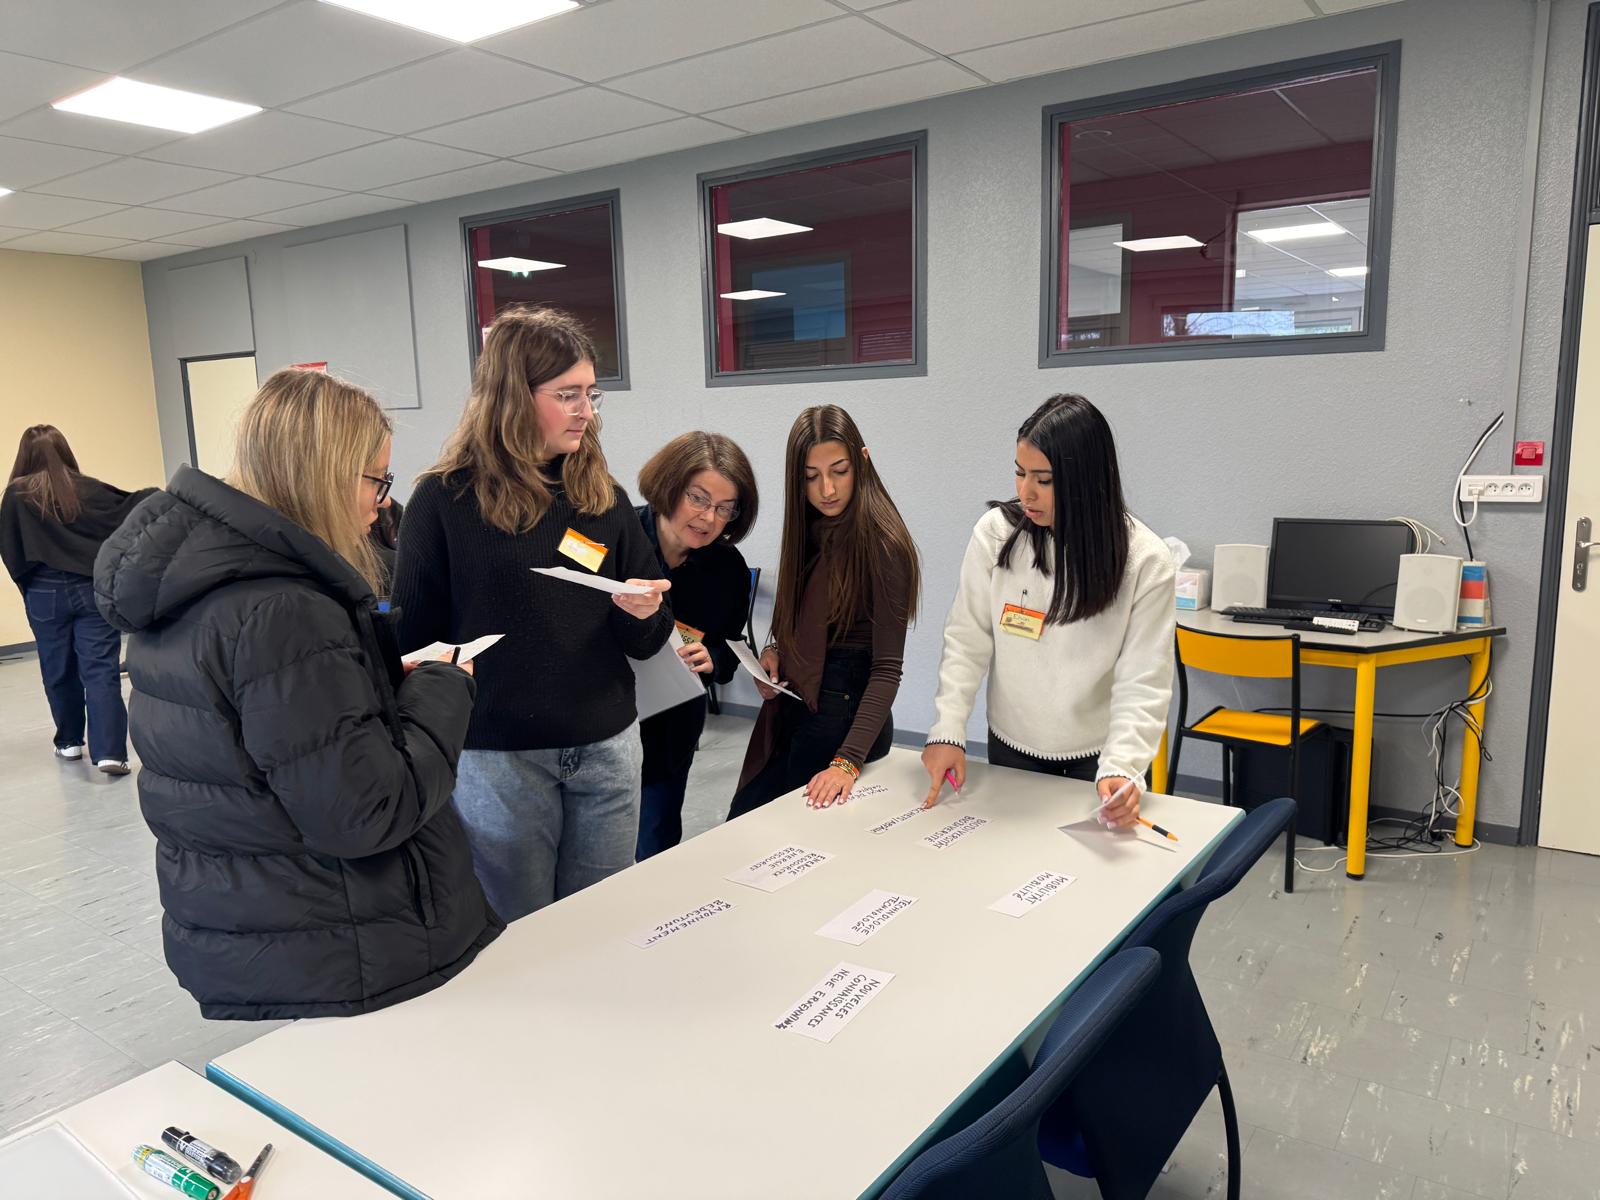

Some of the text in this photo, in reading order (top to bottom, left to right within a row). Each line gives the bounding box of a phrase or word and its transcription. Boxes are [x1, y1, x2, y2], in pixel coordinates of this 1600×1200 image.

[645, 902, 731, 945] RAYONNEMENT
[654, 900, 724, 931] BEDEUTUNG
[861, 898, 912, 935] TECHNOLOGIE
[824, 968, 850, 989] NEUE
[807, 974, 867, 1028] CONNAISSANCES
[834, 978, 881, 1019] NOUVELLES
